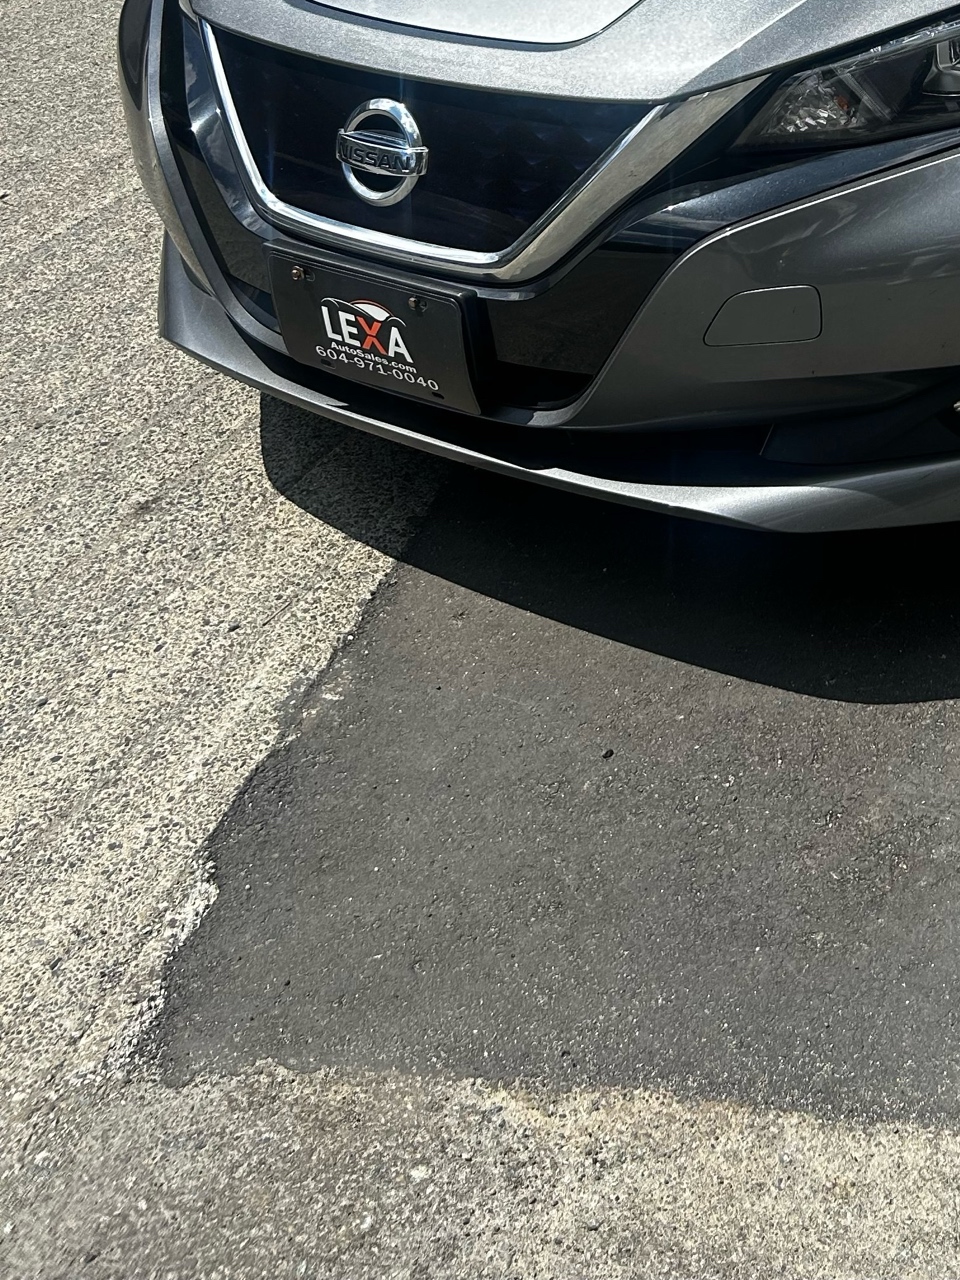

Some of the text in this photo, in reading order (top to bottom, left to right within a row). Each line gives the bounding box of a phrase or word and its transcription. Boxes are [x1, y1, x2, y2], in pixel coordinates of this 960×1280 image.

[340, 142, 411, 173] NISSAN
[321, 305, 414, 363] LEXA
[315, 345, 439, 391] 604-971-0040
[330, 341, 417, 374] AutoSales.com
